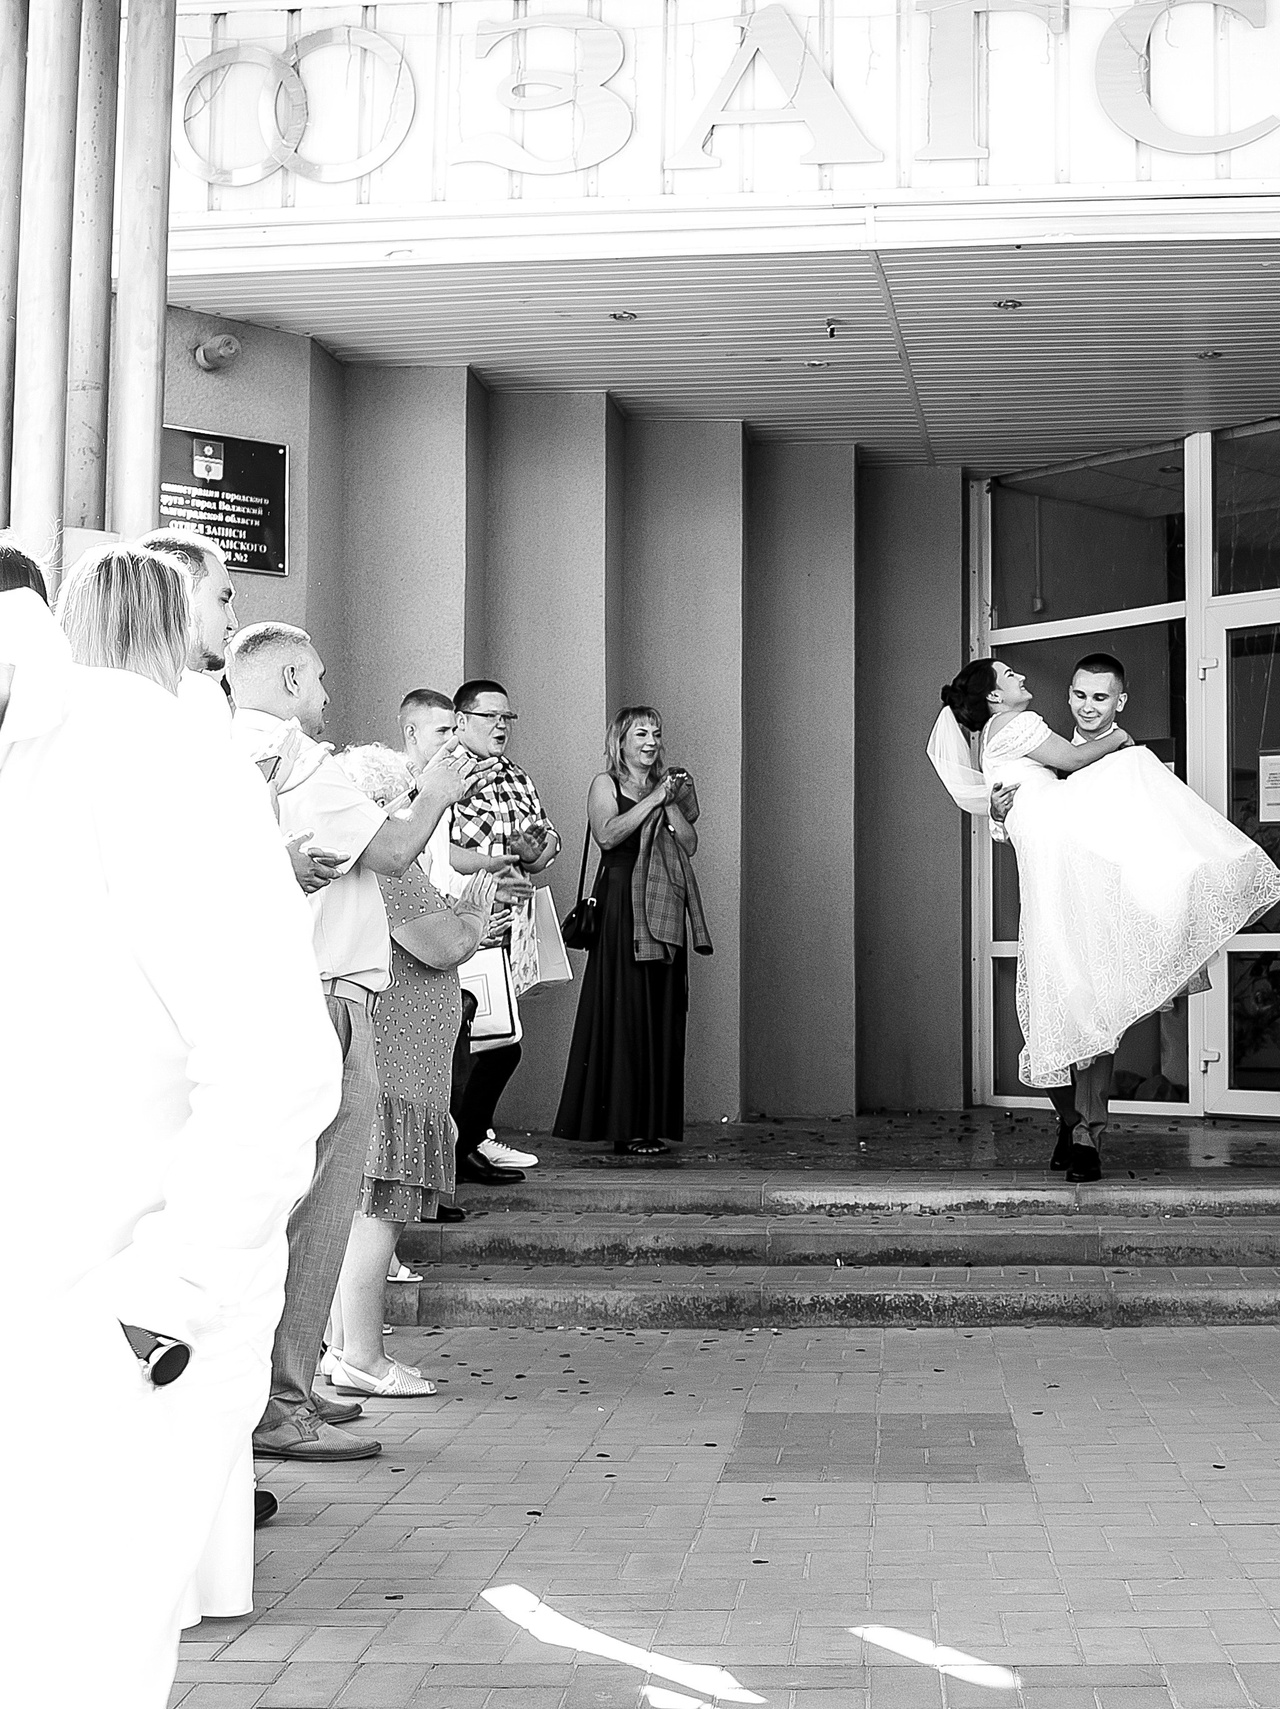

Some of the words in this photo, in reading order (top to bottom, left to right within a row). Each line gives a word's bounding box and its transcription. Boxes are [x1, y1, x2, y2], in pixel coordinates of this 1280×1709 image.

[221, 491, 269, 505] городского
[191, 498, 217, 510] город
[218, 500, 263, 516] Волжский
[225, 513, 260, 527] области
[205, 525, 247, 539] ЗАПИСИ
